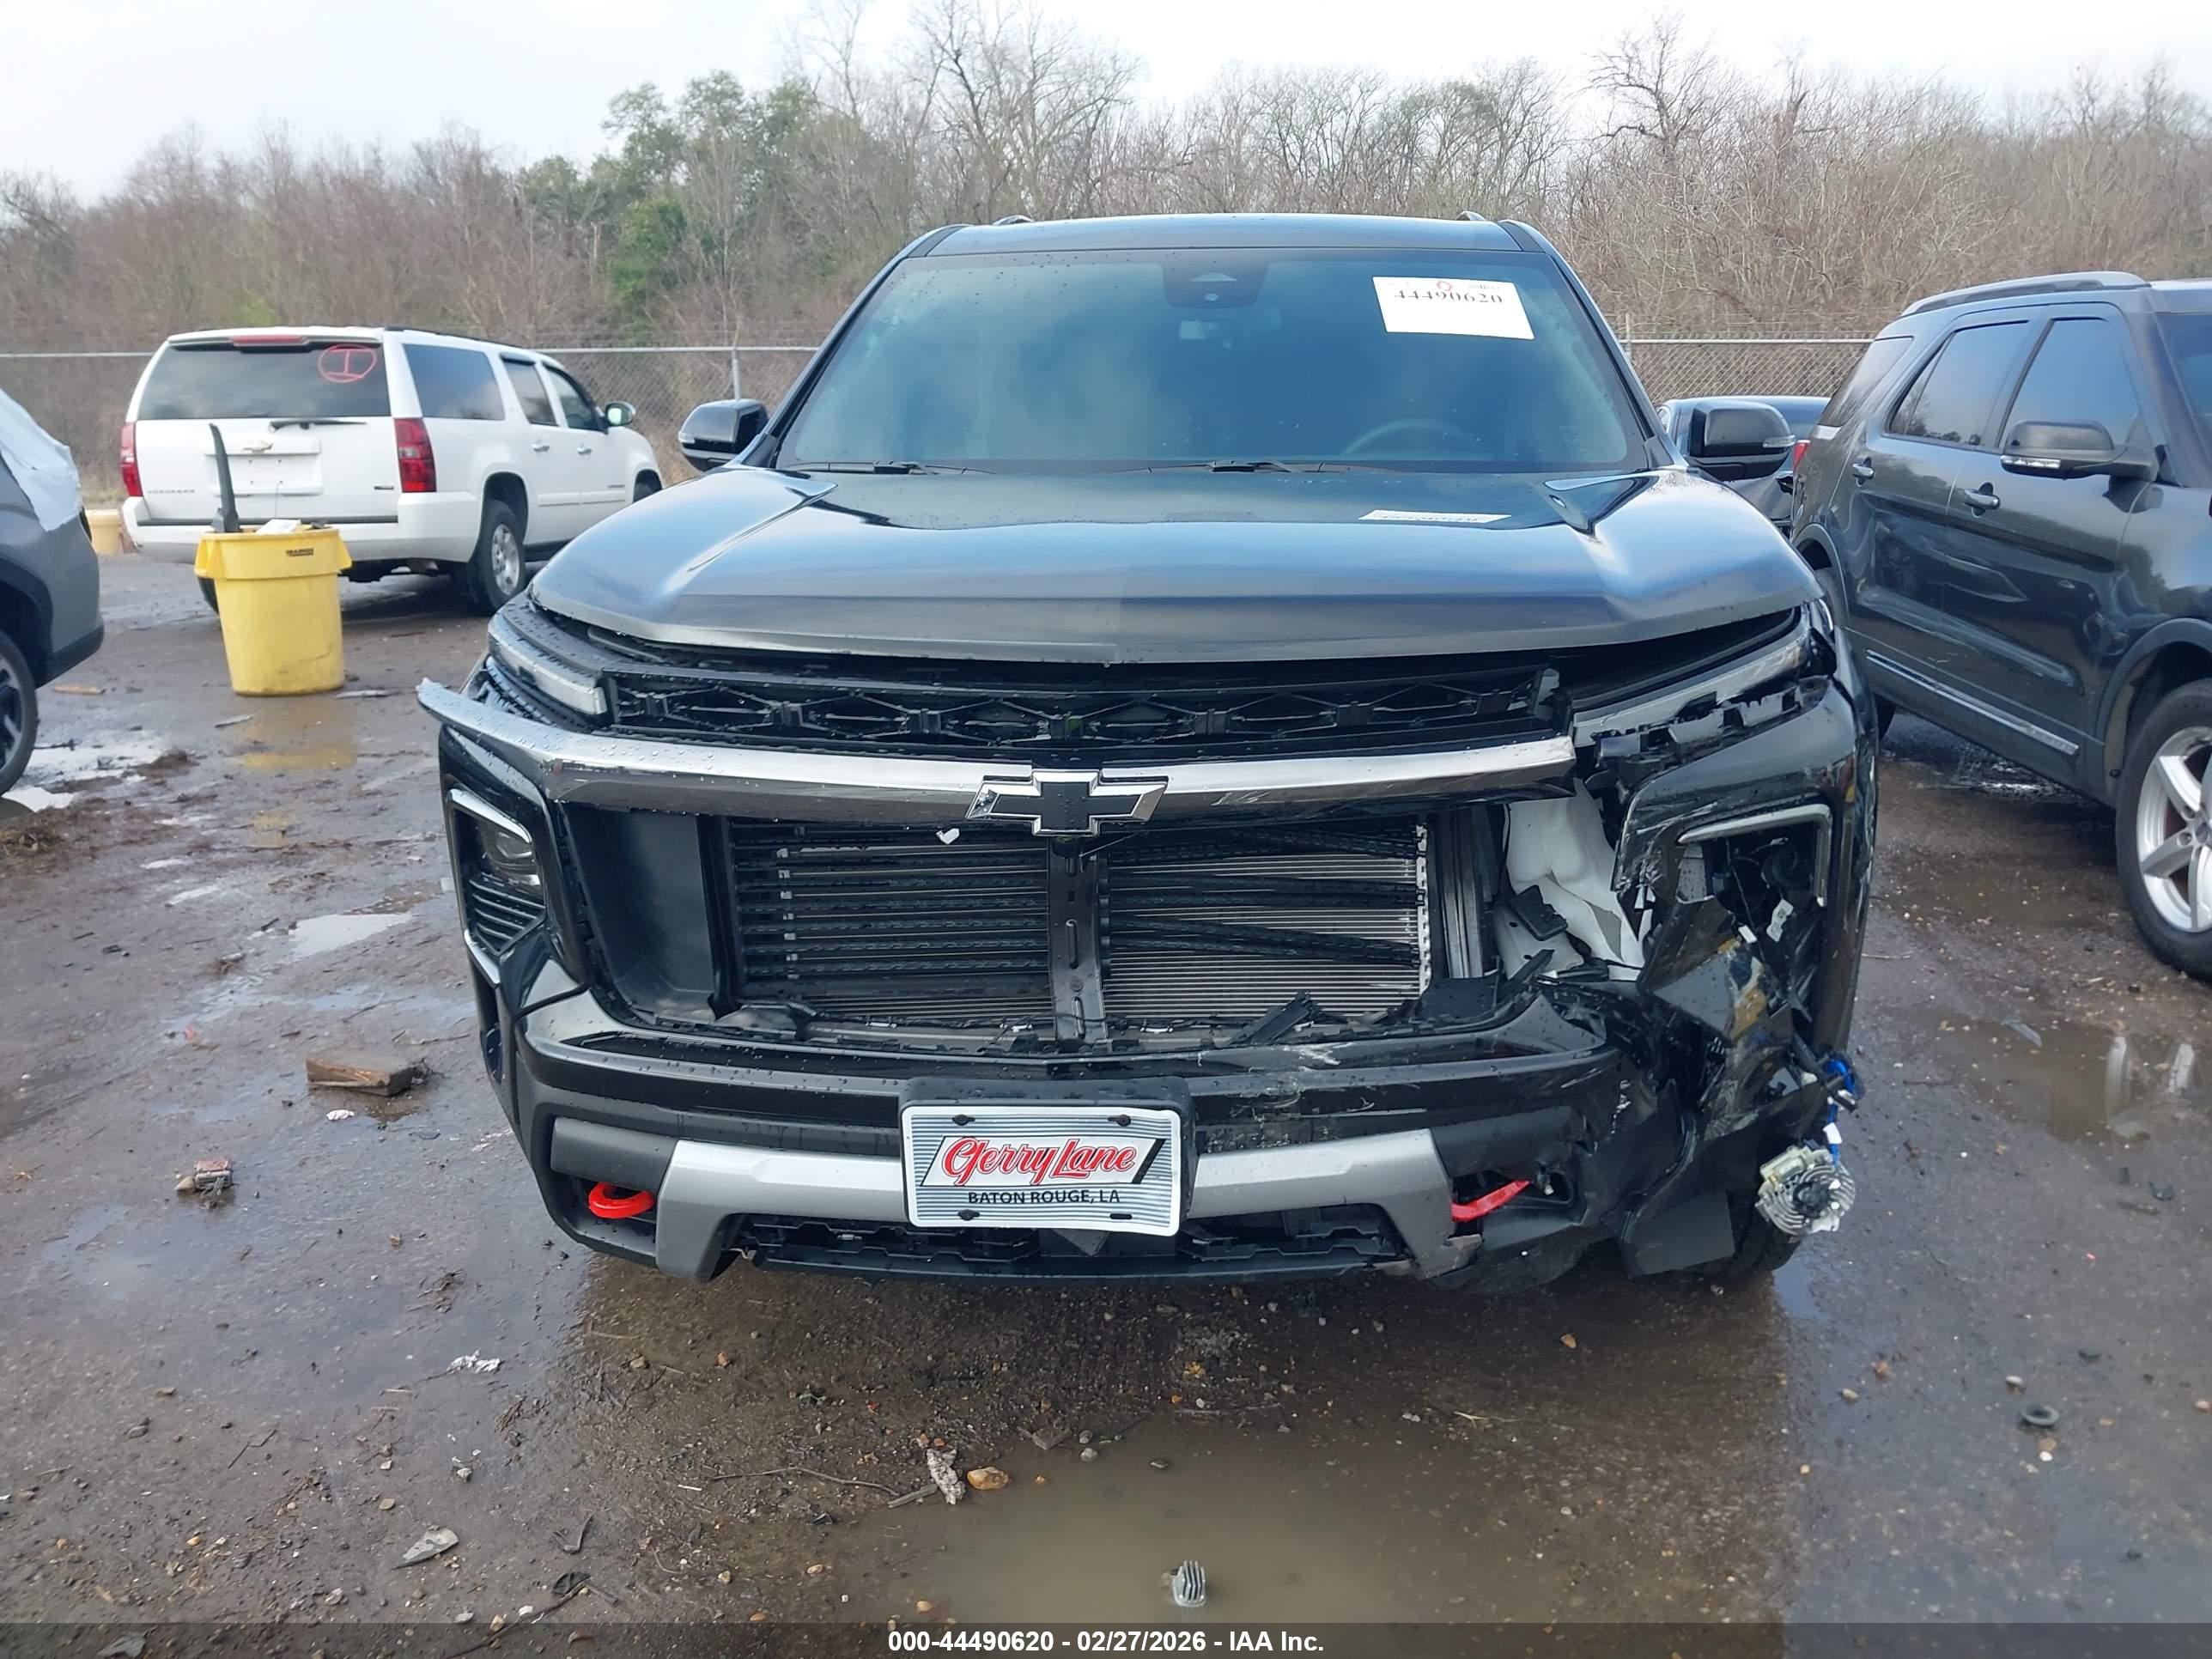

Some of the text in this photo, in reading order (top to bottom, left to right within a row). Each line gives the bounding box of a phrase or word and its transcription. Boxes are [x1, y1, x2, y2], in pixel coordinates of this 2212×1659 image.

[1395, 289, 1504, 304] 44490620
[943, 1136, 1137, 1186] Gerry Lane
[968, 1189, 1121, 1204] BATON ROUGE, LA
